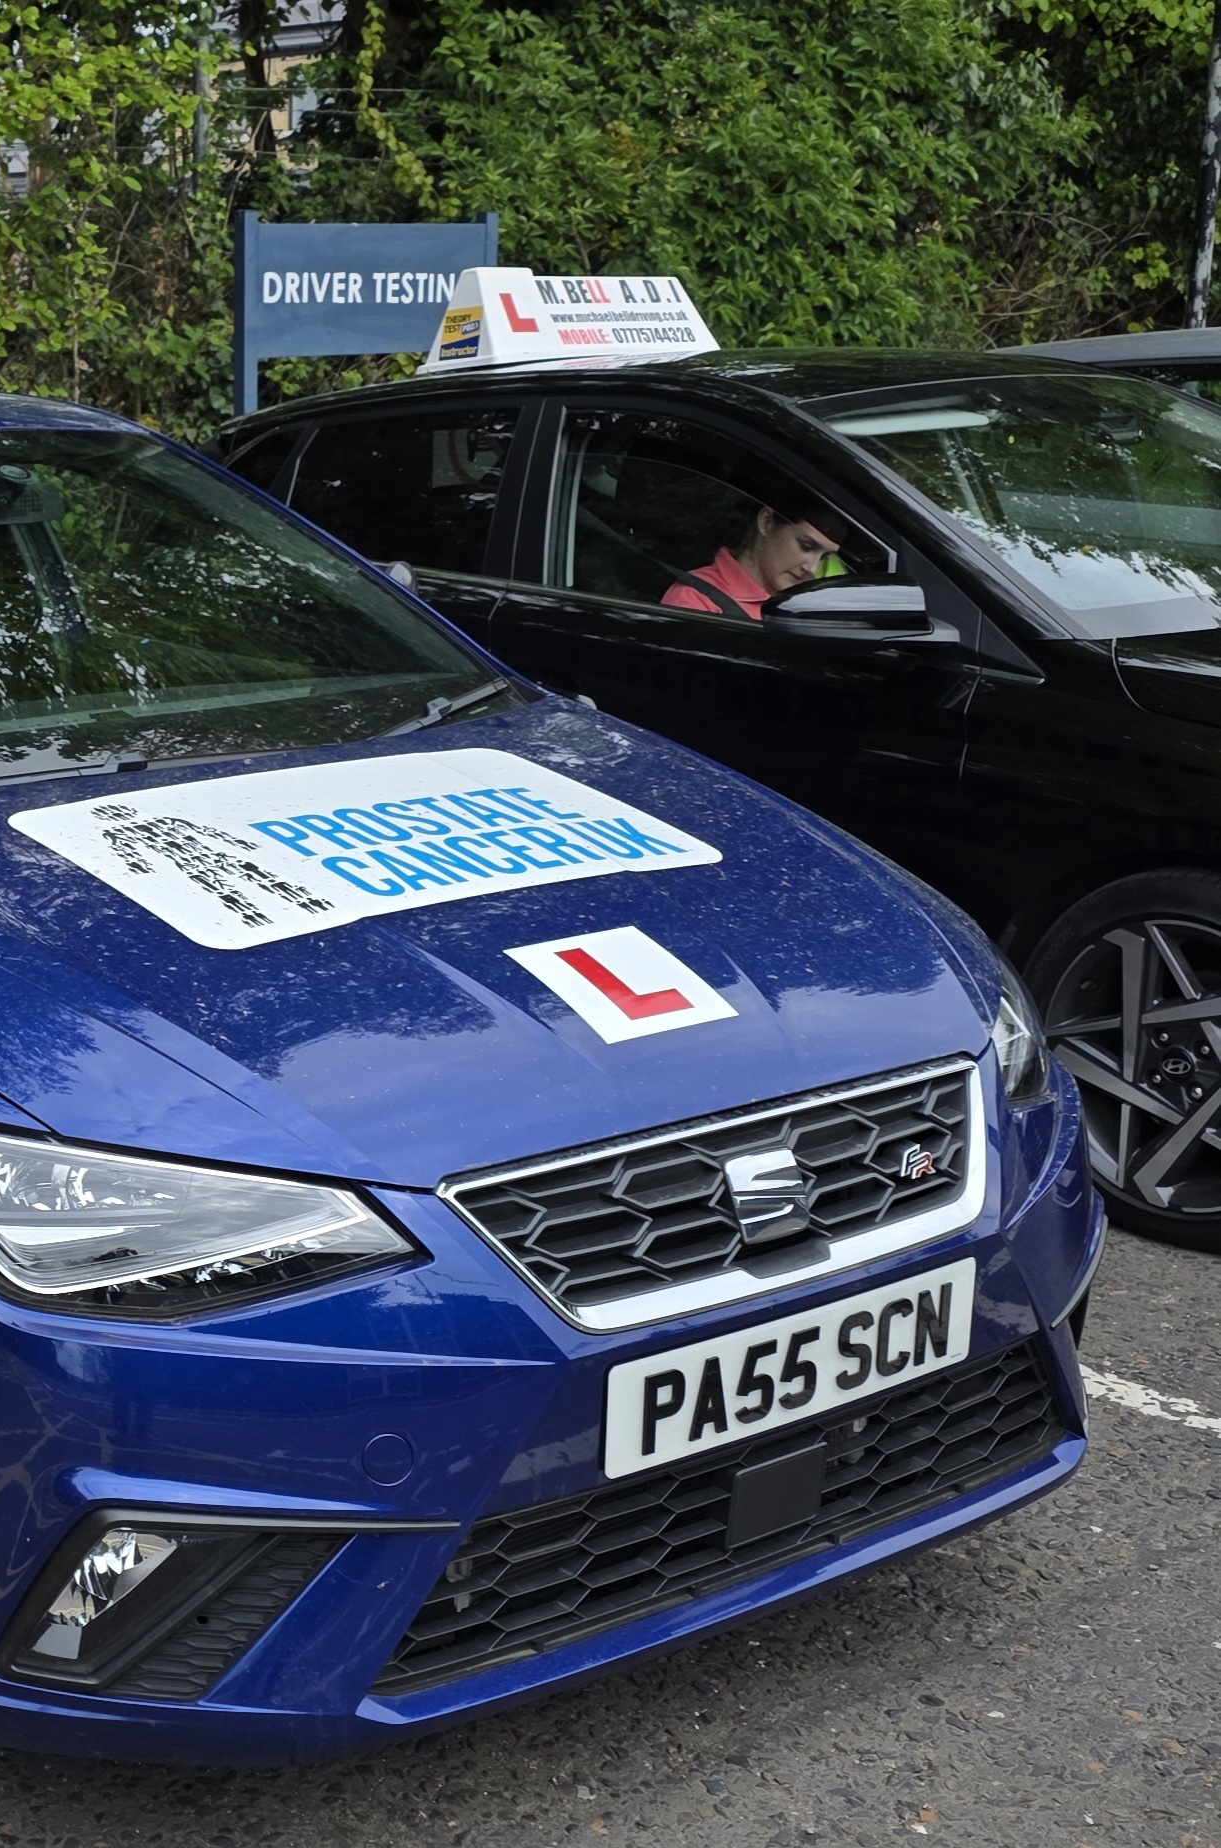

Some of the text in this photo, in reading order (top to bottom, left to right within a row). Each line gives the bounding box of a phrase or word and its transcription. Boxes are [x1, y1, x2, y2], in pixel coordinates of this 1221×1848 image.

[262, 271, 456, 304] DRIVER TESTIN
[443, 324, 461, 334] TEST
[445, 313, 473, 324] THEORY
[498, 292, 540, 332] L
[549, 310, 690, 324] www.michaelbelldriving.co.uk
[557, 327, 697, 346] MOBILE: 07775744328
[246, 787, 586, 857] PROSTATE
[320, 817, 690, 897] CANCER UK
[554, 948, 696, 1021] L
[641, 1281, 953, 1457] PA55 SCN
